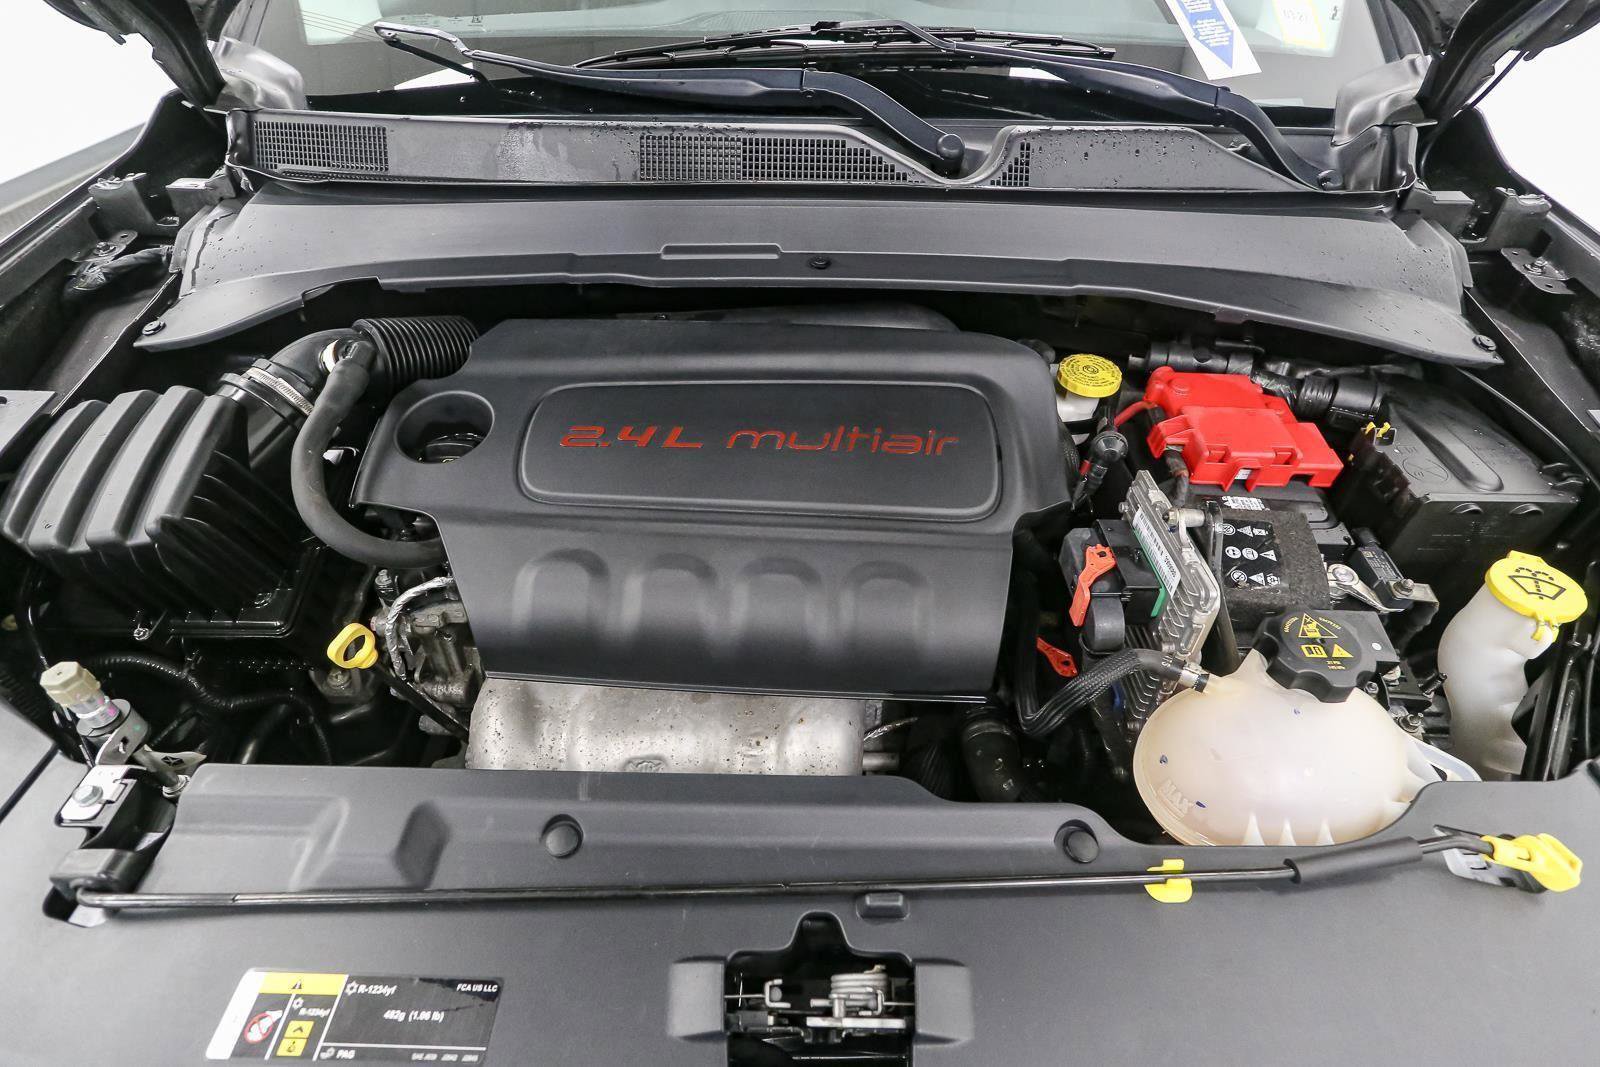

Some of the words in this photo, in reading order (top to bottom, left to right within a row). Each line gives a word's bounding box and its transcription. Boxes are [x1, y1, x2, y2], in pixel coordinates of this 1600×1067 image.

[726, 425, 960, 456] multiair
[357, 984, 397, 997] R-1234yf
[456, 983, 472, 992] FCA
[472, 984, 483, 992] US
[483, 985, 499, 993] LLC
